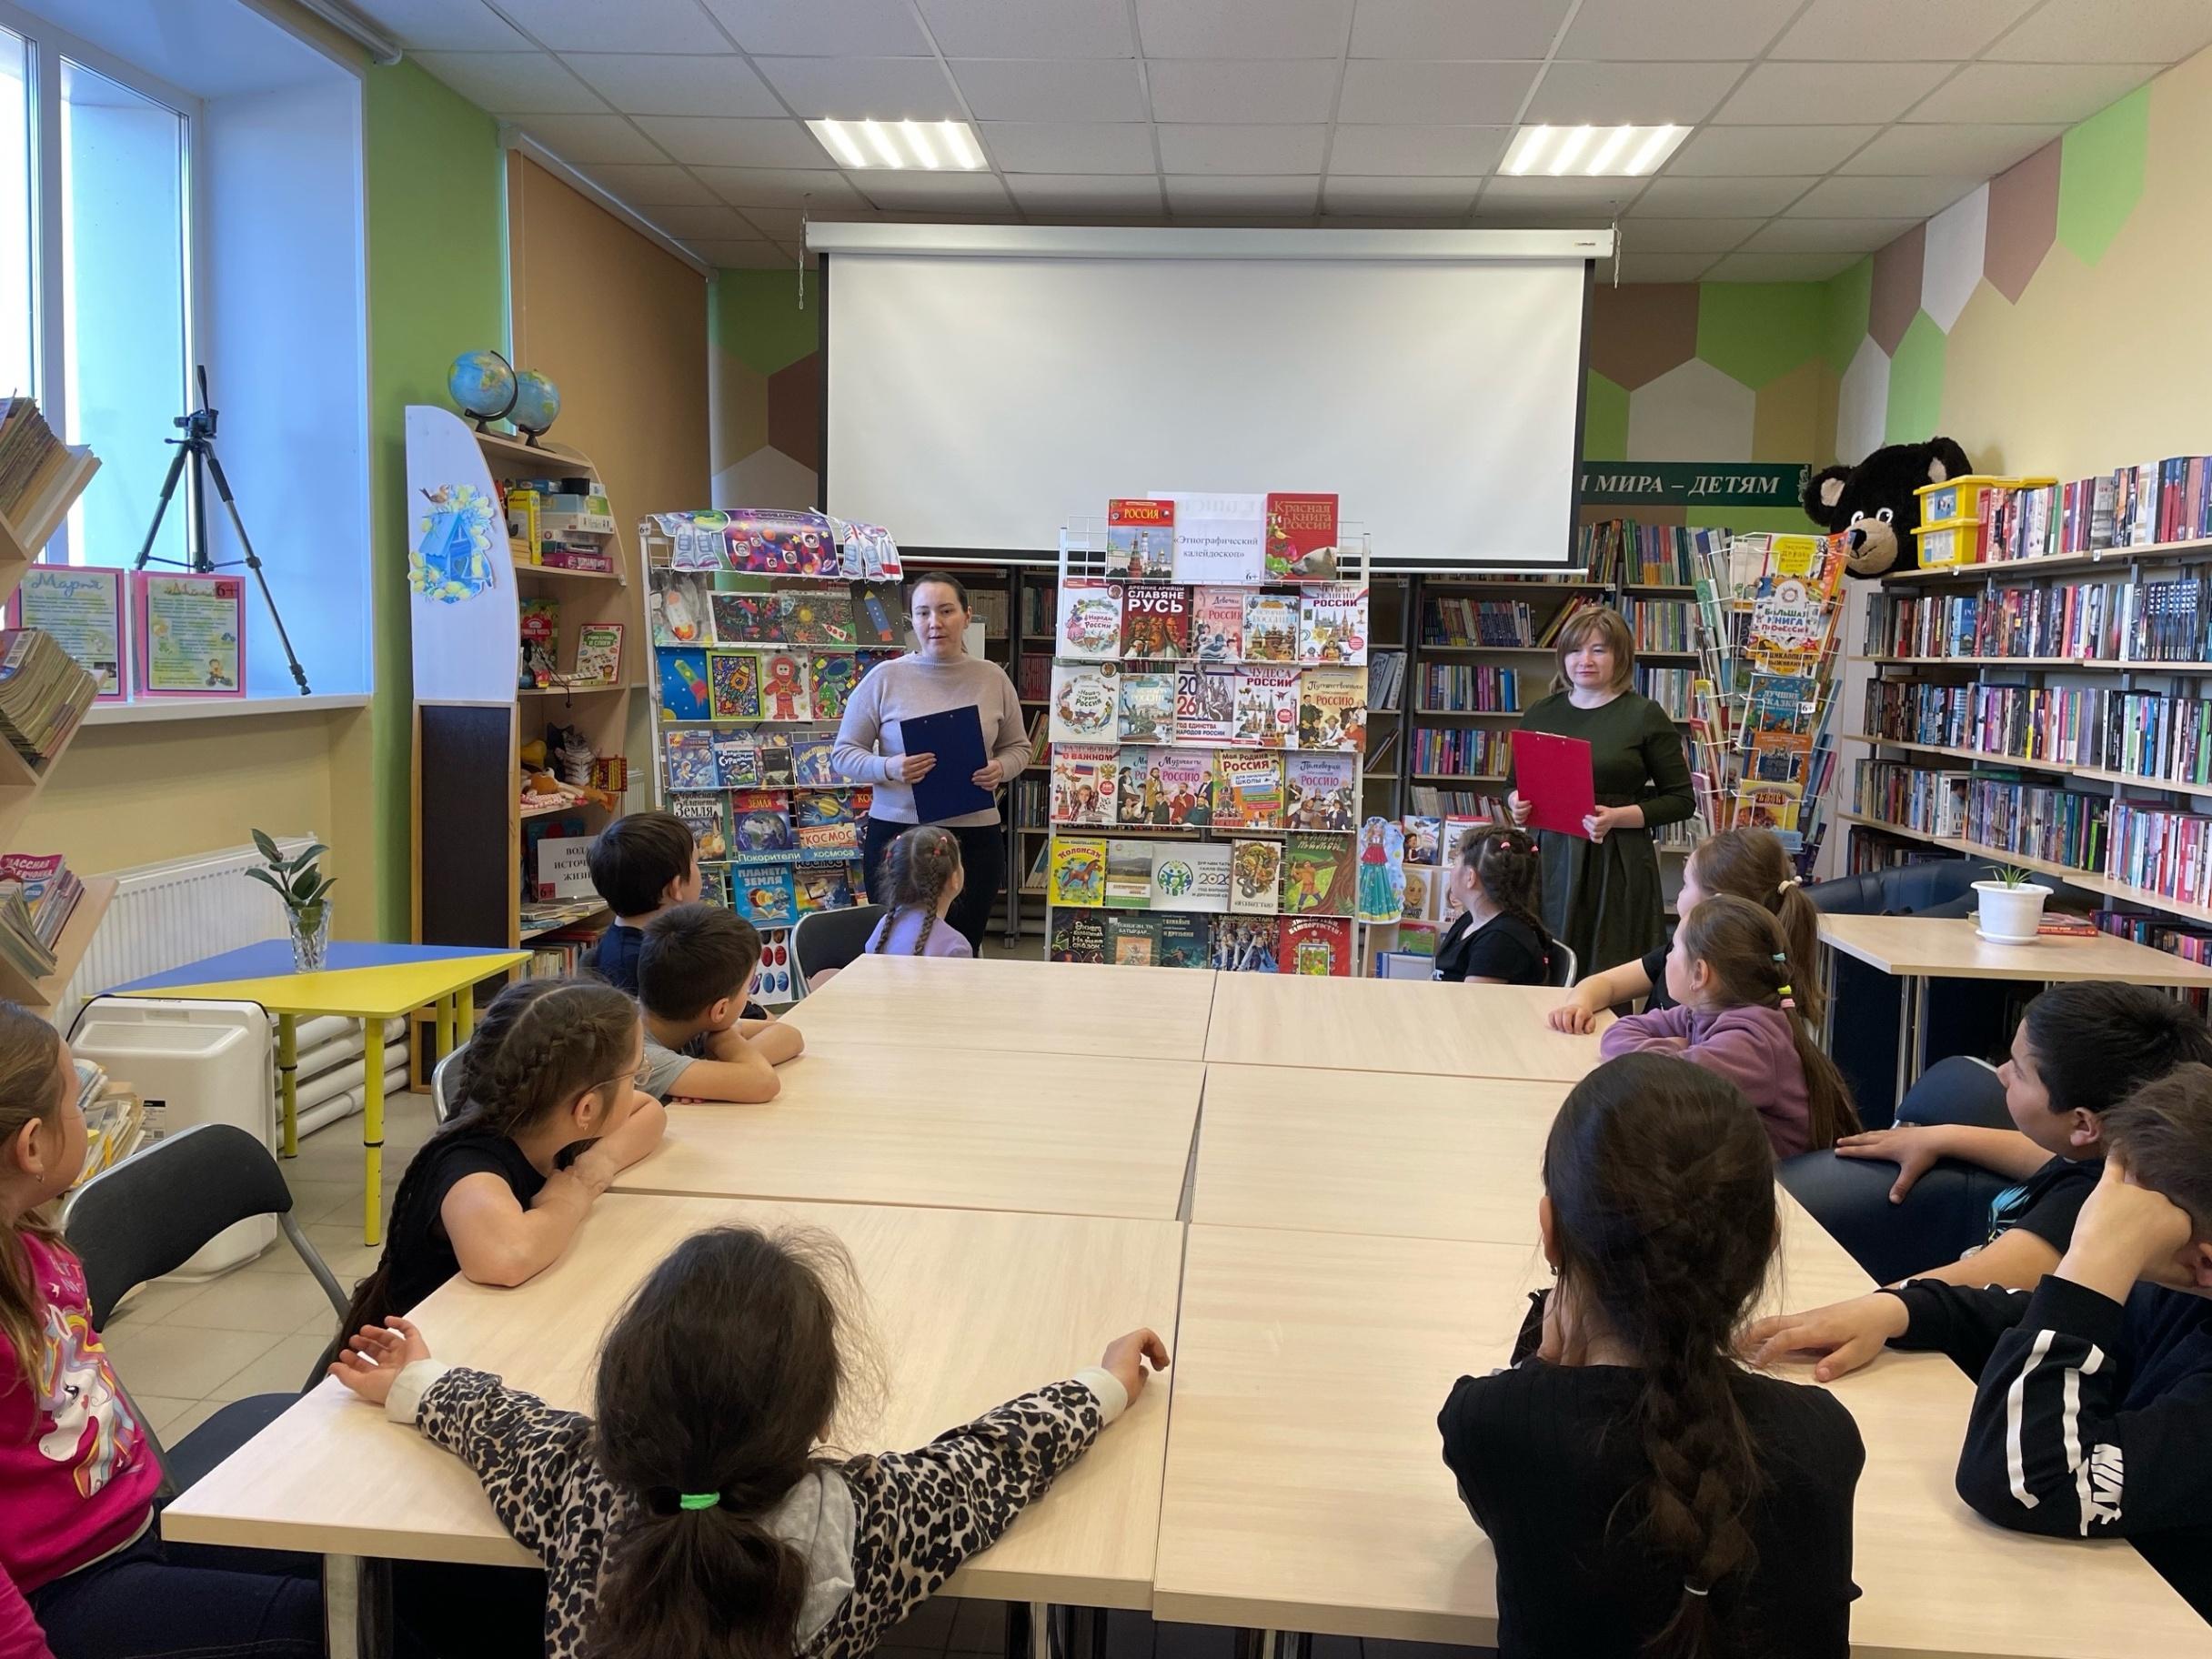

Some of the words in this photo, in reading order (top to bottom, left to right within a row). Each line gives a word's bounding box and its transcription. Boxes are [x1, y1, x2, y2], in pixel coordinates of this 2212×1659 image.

[1594, 475, 1664, 494] МИРА
[1688, 476, 1781, 498] ДЕТЯМ
[1123, 508, 1160, 519] РОССИЯ
[639, 527, 649, 535] 6+
[1246, 572, 1259, 580] 6+
[216, 584, 236, 597] 6+
[1128, 590, 1184, 599] СЛАВЯНЕ
[1128, 598, 1183, 613] РУСЬ
[1250, 667, 1292, 678] ЧУДЕСА
[1178, 676, 1197, 695] 20
[1247, 678, 1292, 687] РОССИИ
[1177, 696, 1196, 715] 26
[1316, 695, 1354, 706] РОССИЮ
[1071, 753, 1113, 761] ВАЖНОМ
[1239, 752, 1268, 761] Родина
[1162, 770, 1200, 782] РОССИЮ
[1302, 776, 1339, 786] РОССИЮ
[676, 801, 713, 817] Земля
[748, 799, 772, 809] ЗЕМЛЯ
[806, 829, 853, 845] КОСМОС
[738, 852, 800, 863] Покорители
[813, 849, 855, 859] космоса
[738, 868, 788, 878] ПЛАНЕТА
[744, 877, 783, 887] ЗЕМЛЯ
